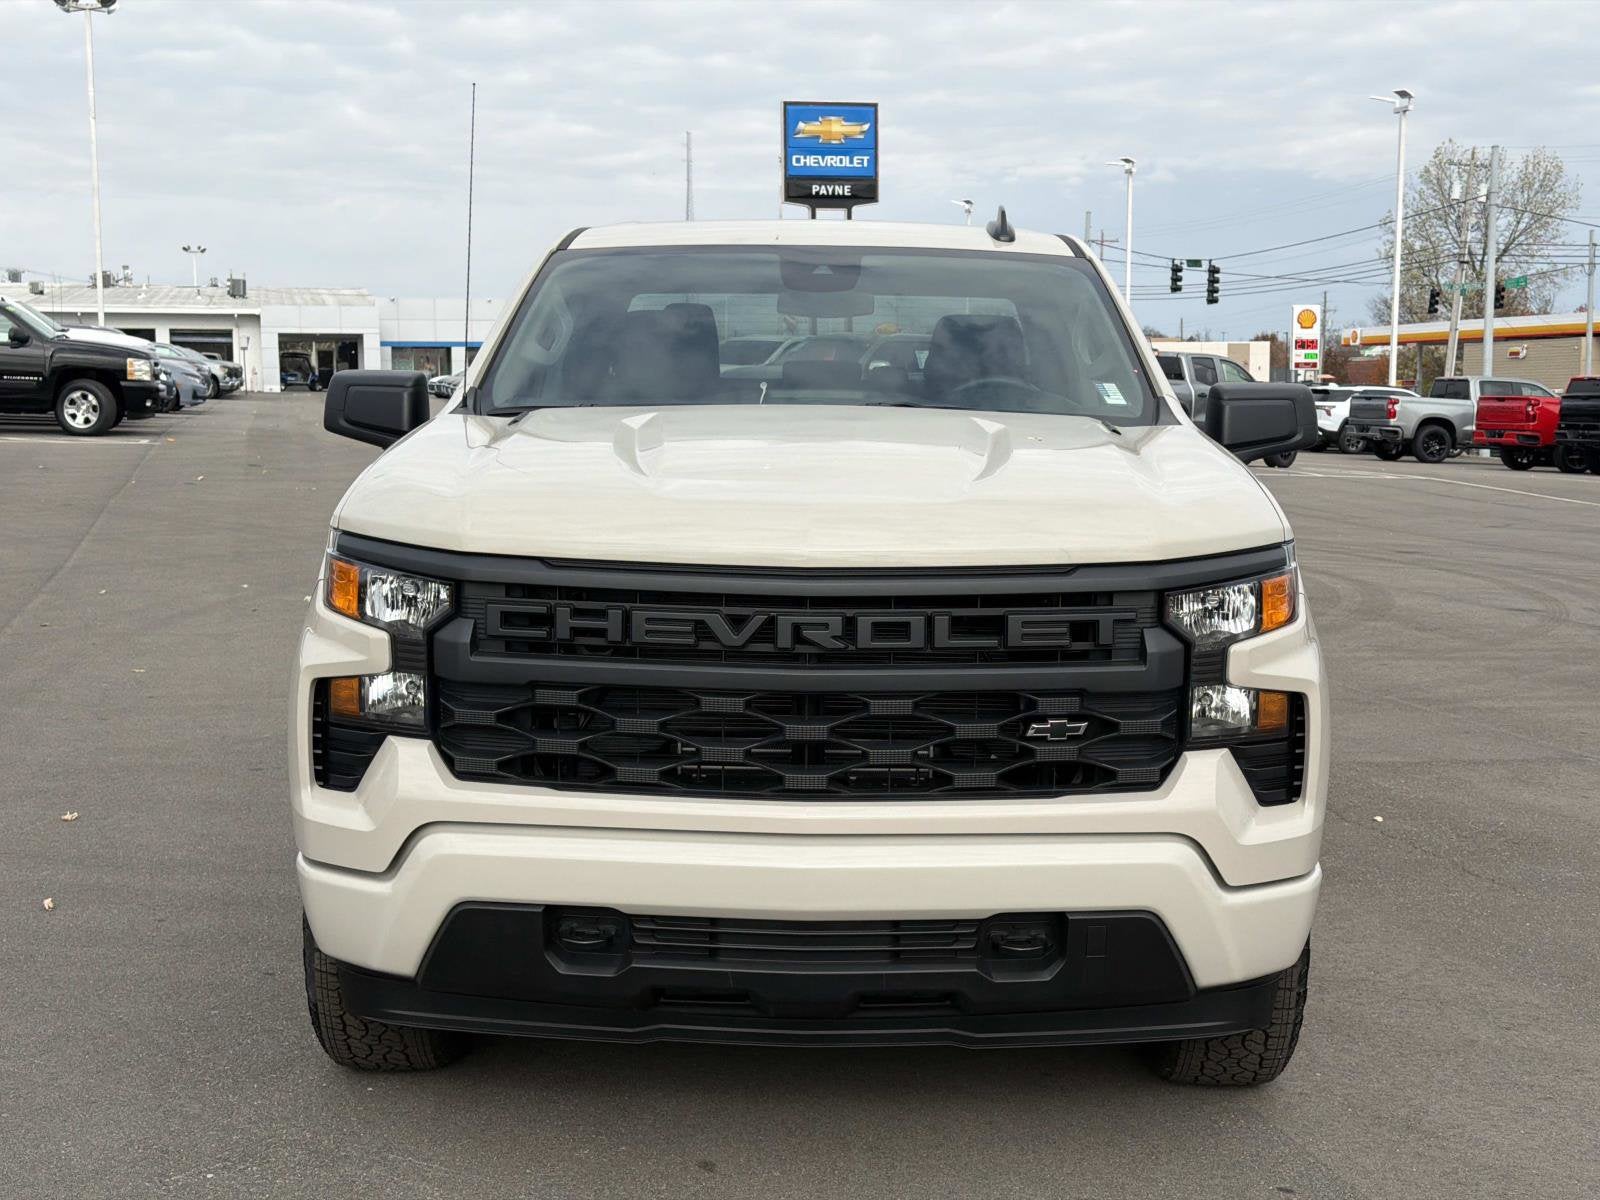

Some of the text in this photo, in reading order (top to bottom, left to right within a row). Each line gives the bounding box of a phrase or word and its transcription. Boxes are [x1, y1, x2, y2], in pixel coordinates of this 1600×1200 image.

[792, 155, 870, 167] CHEVROLET
[812, 184, 852, 196] PAYNE
[486, 604, 1137, 649] CHEVROLET
